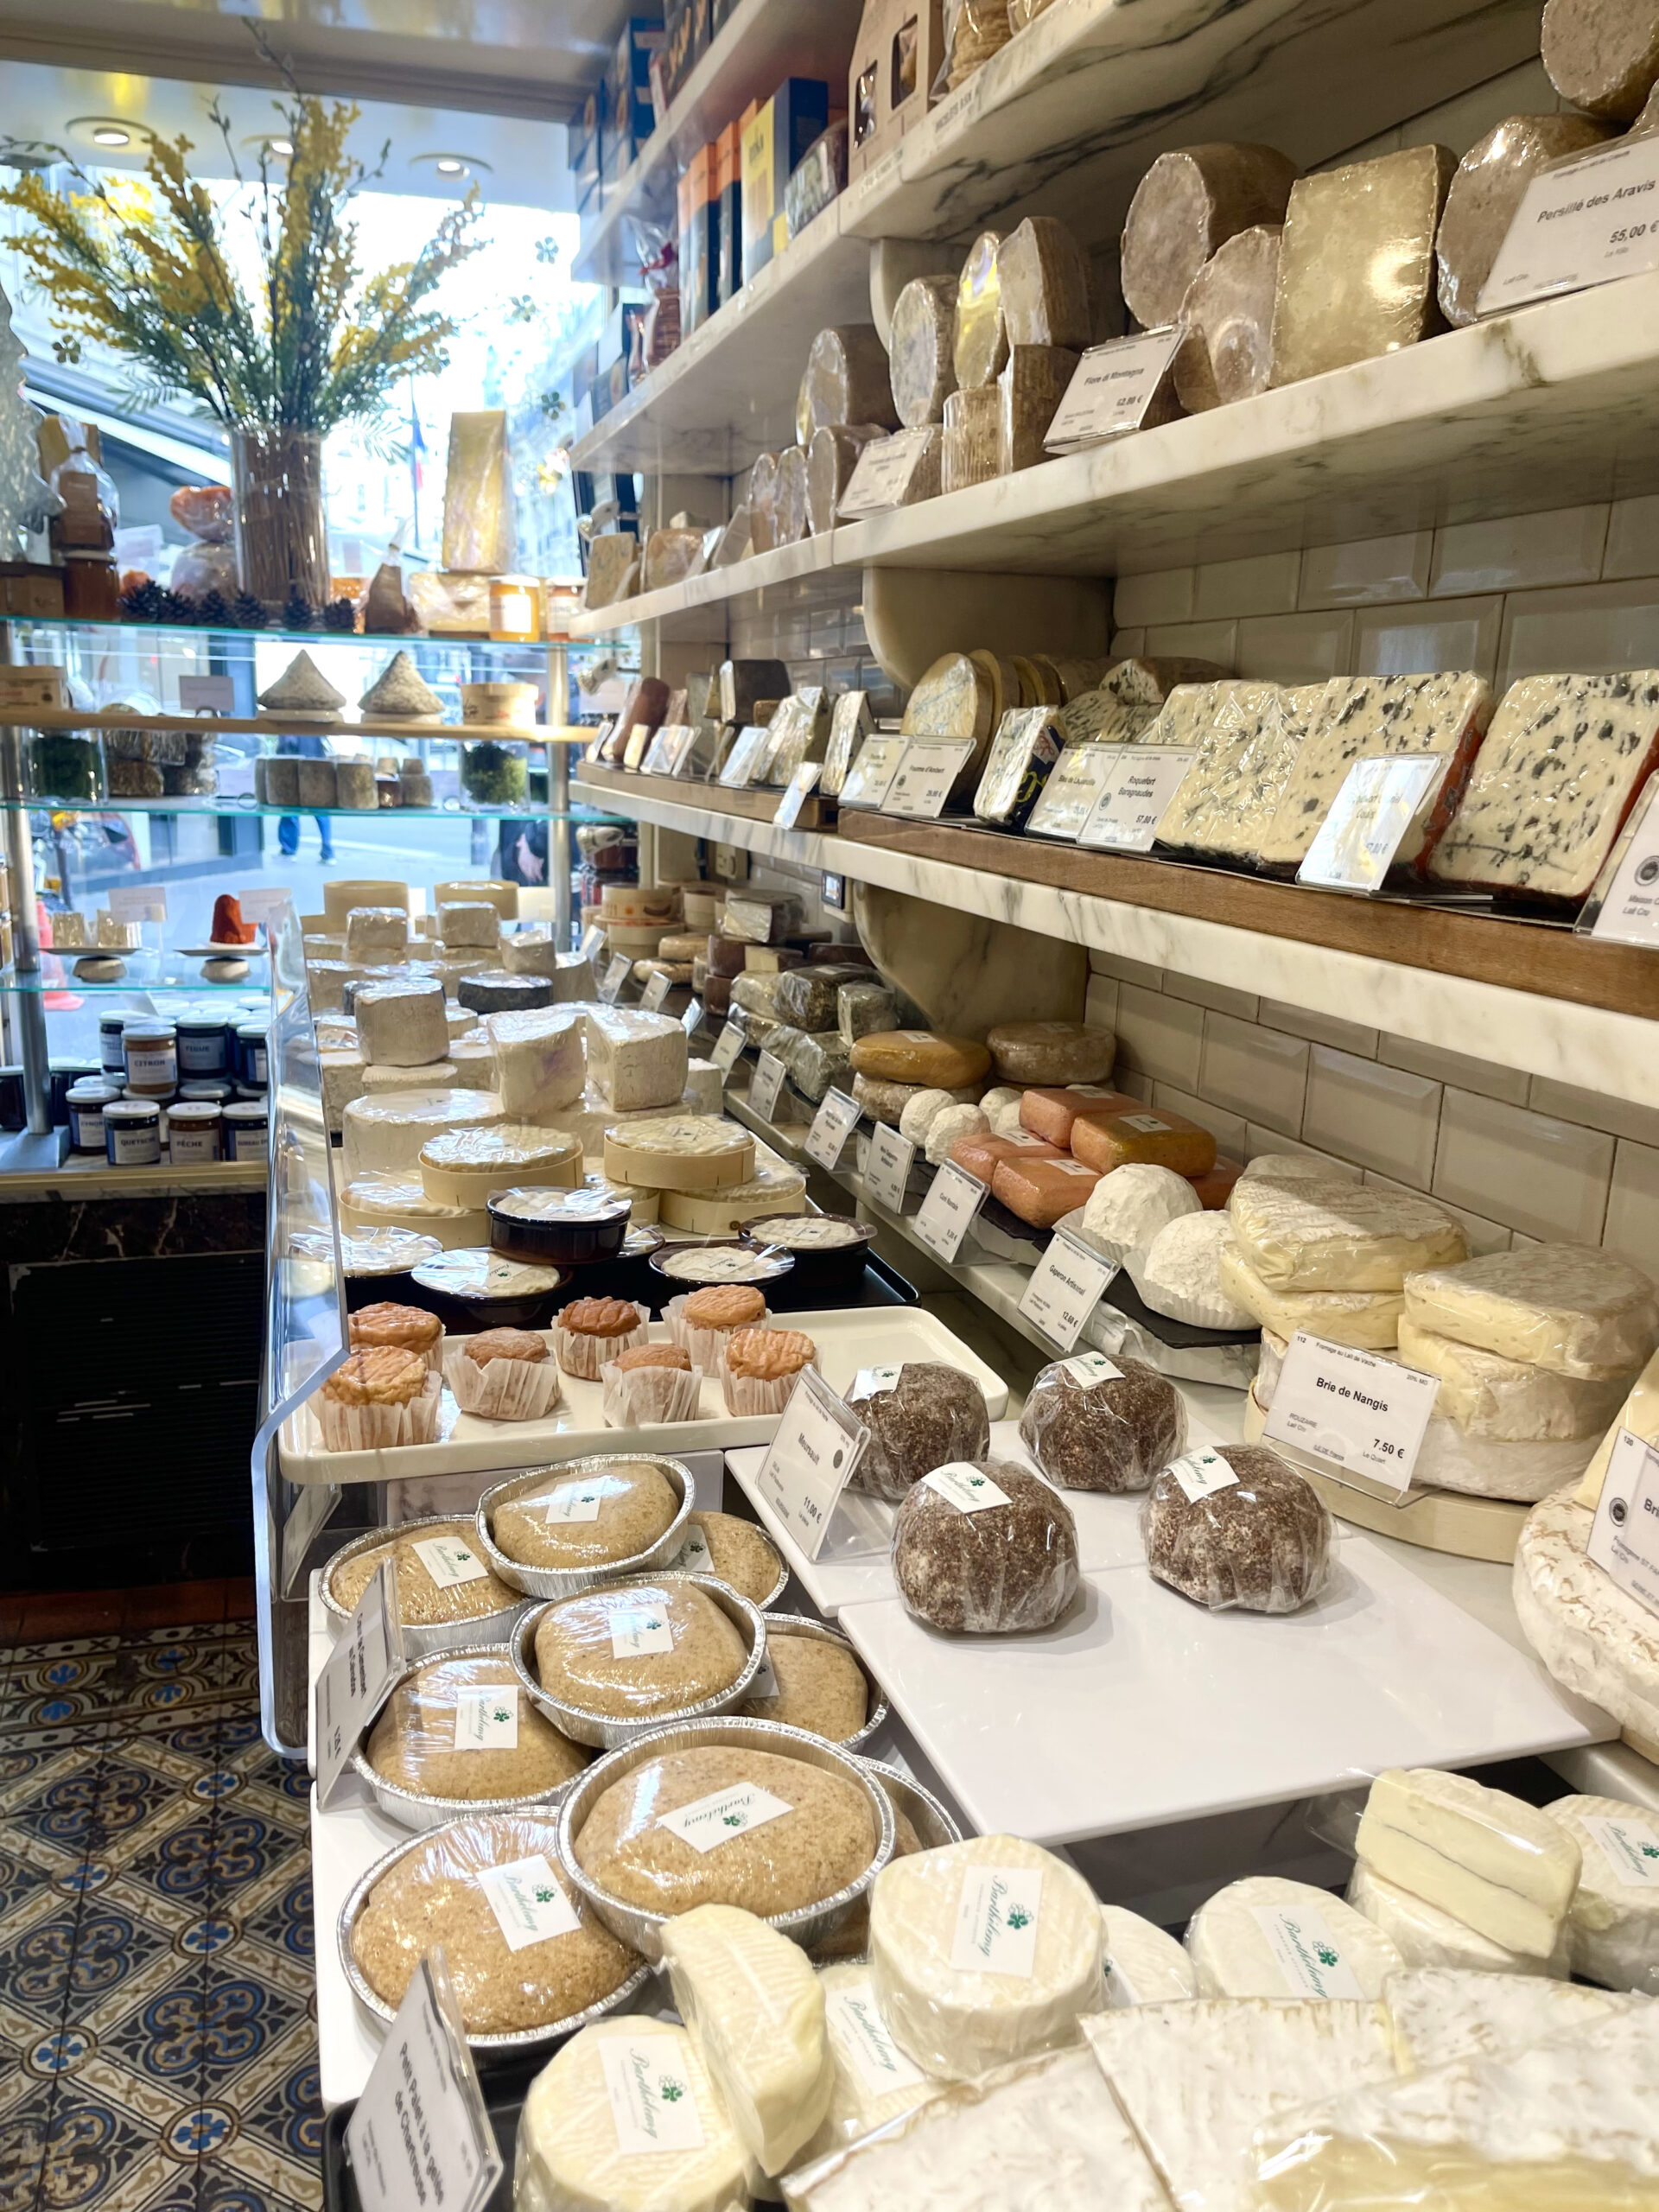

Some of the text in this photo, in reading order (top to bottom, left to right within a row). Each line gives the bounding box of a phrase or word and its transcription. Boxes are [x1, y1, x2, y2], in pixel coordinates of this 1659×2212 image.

[1537, 180, 1656, 223] Persillé des Aravis
[1610, 224, 1646, 244] 55,00
[1128, 776, 1156, 788] Roquefort
[1049, 1265, 1085, 1296] Gaperon Artisanal
[1316, 1342, 1337, 1353] Fromage
[1316, 1377, 1389, 1412] Brie de Nangis
[798, 1432, 820, 1465] Meursault
[1373, 1439, 1405, 1459] 7.50 €
[1624, 1435, 1634, 1446] 120
[817, 1513, 823, 1524] €
[395, 2091, 427, 2207] de Chartreuse
